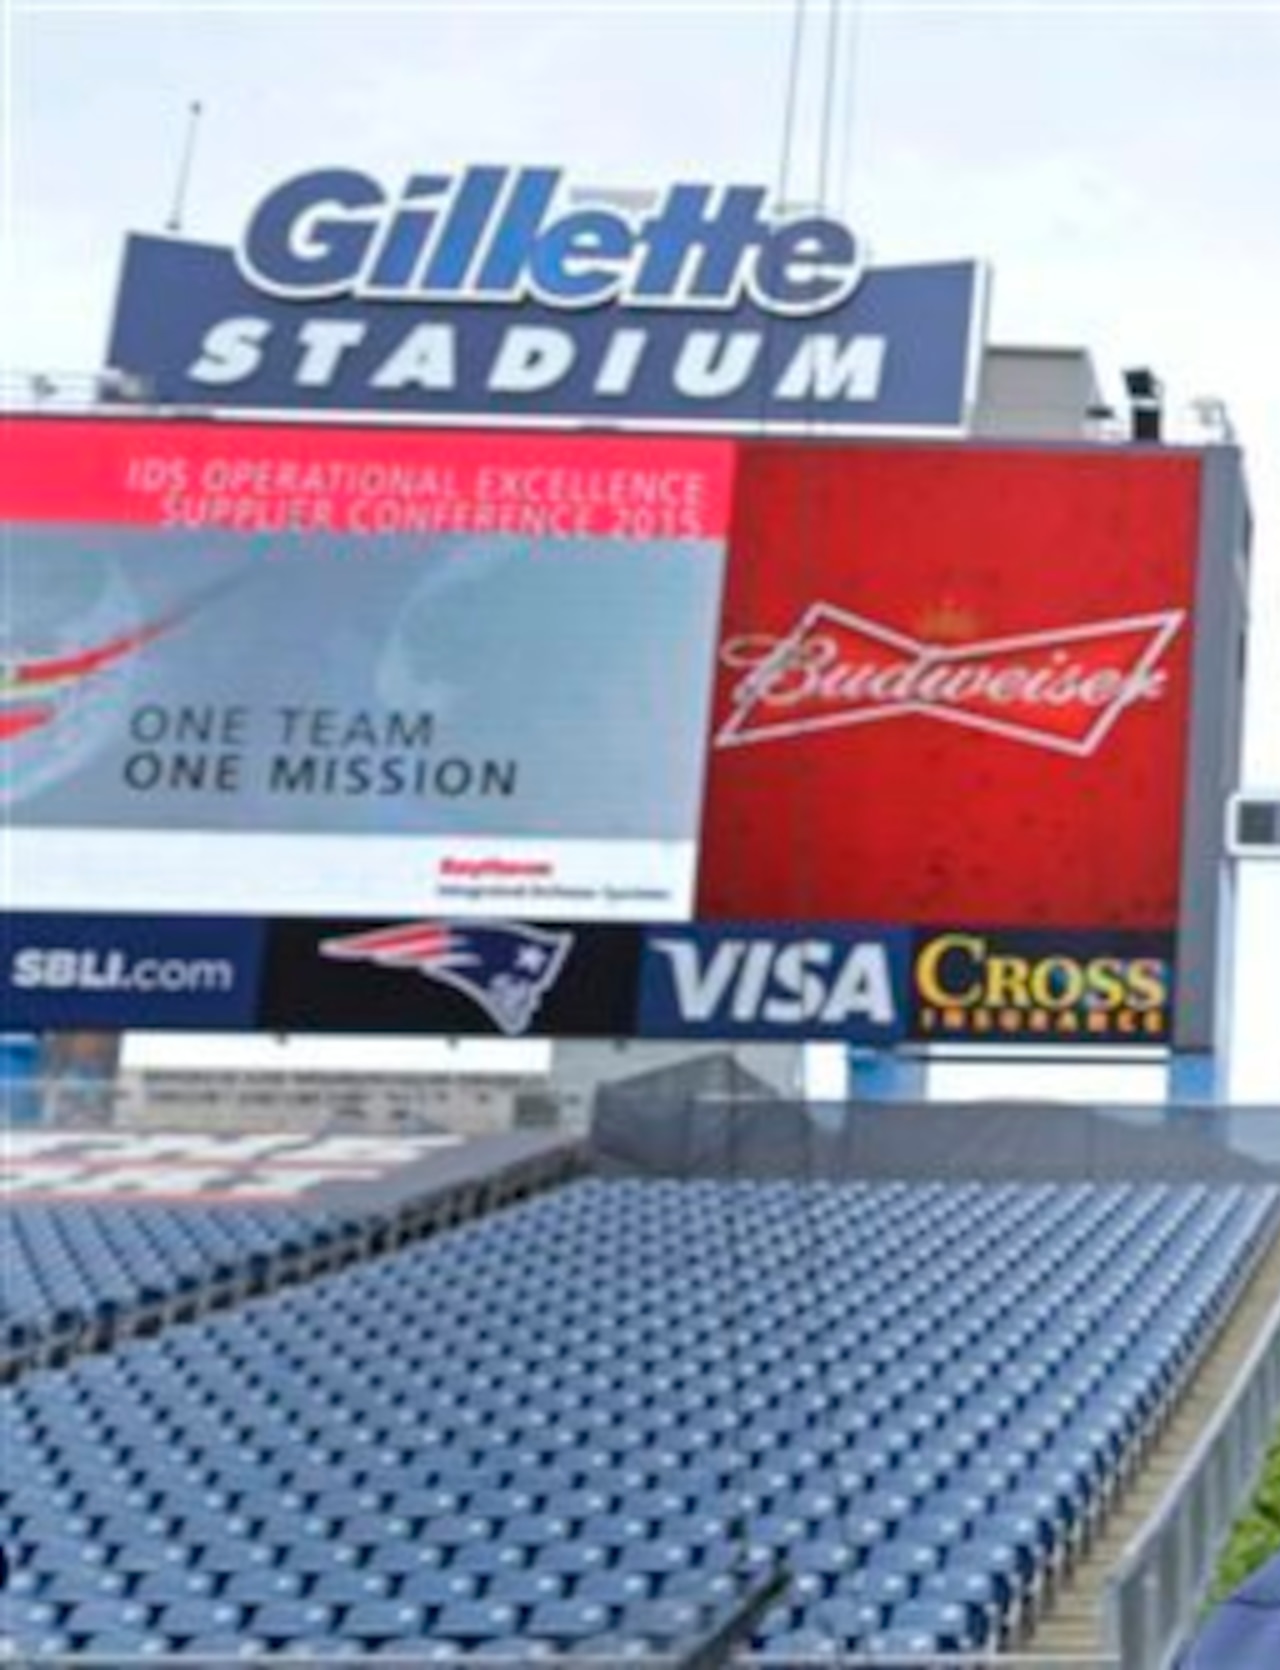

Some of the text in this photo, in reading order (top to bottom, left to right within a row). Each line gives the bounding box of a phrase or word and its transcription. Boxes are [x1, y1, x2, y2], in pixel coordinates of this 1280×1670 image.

[240, 164, 862, 314] Gillette
[189, 317, 887, 402] STADIUM
[126, 456, 706, 505] IDS OPERATIONAL EXCELLENCE
[160, 496, 334, 533] SUPPLIER
[347, 499, 593, 540] CONFERENCE
[720, 634, 1167, 706] Budweiser
[130, 705, 435, 749] ONE TEAM
[123, 750, 518, 797] ONE MISSION
[12, 948, 233, 991] SBLI.com
[649, 940, 896, 1023] VISA
[916, 932, 1166, 1010] CROSS
